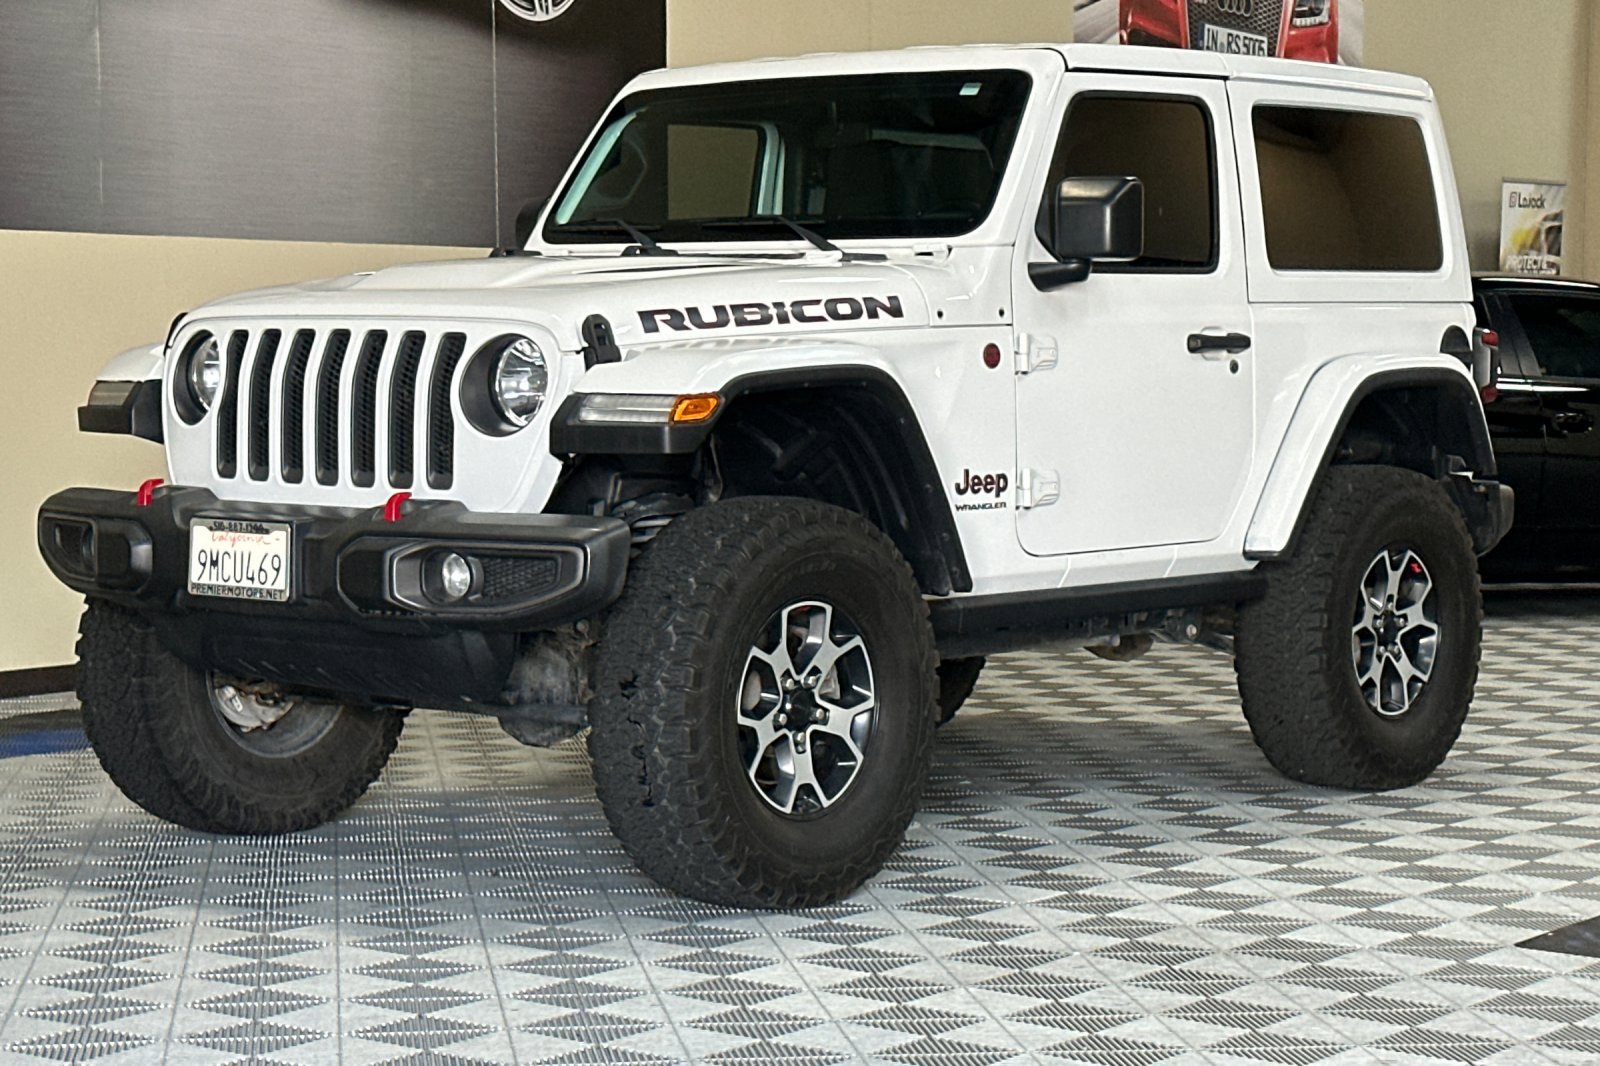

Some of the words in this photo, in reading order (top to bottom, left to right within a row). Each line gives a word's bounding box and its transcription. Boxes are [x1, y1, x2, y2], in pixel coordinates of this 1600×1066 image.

[1206, 27, 1219, 52] IN
[1226, 32, 1240, 54] RS
[637, 295, 904, 333] RUBICON
[954, 468, 1008, 498] Jeep
[954, 501, 1007, 511] WRANGLER
[198, 549, 281, 586] 9MCU469
[191, 583, 285, 600] PREMIERMOTORS.NET
